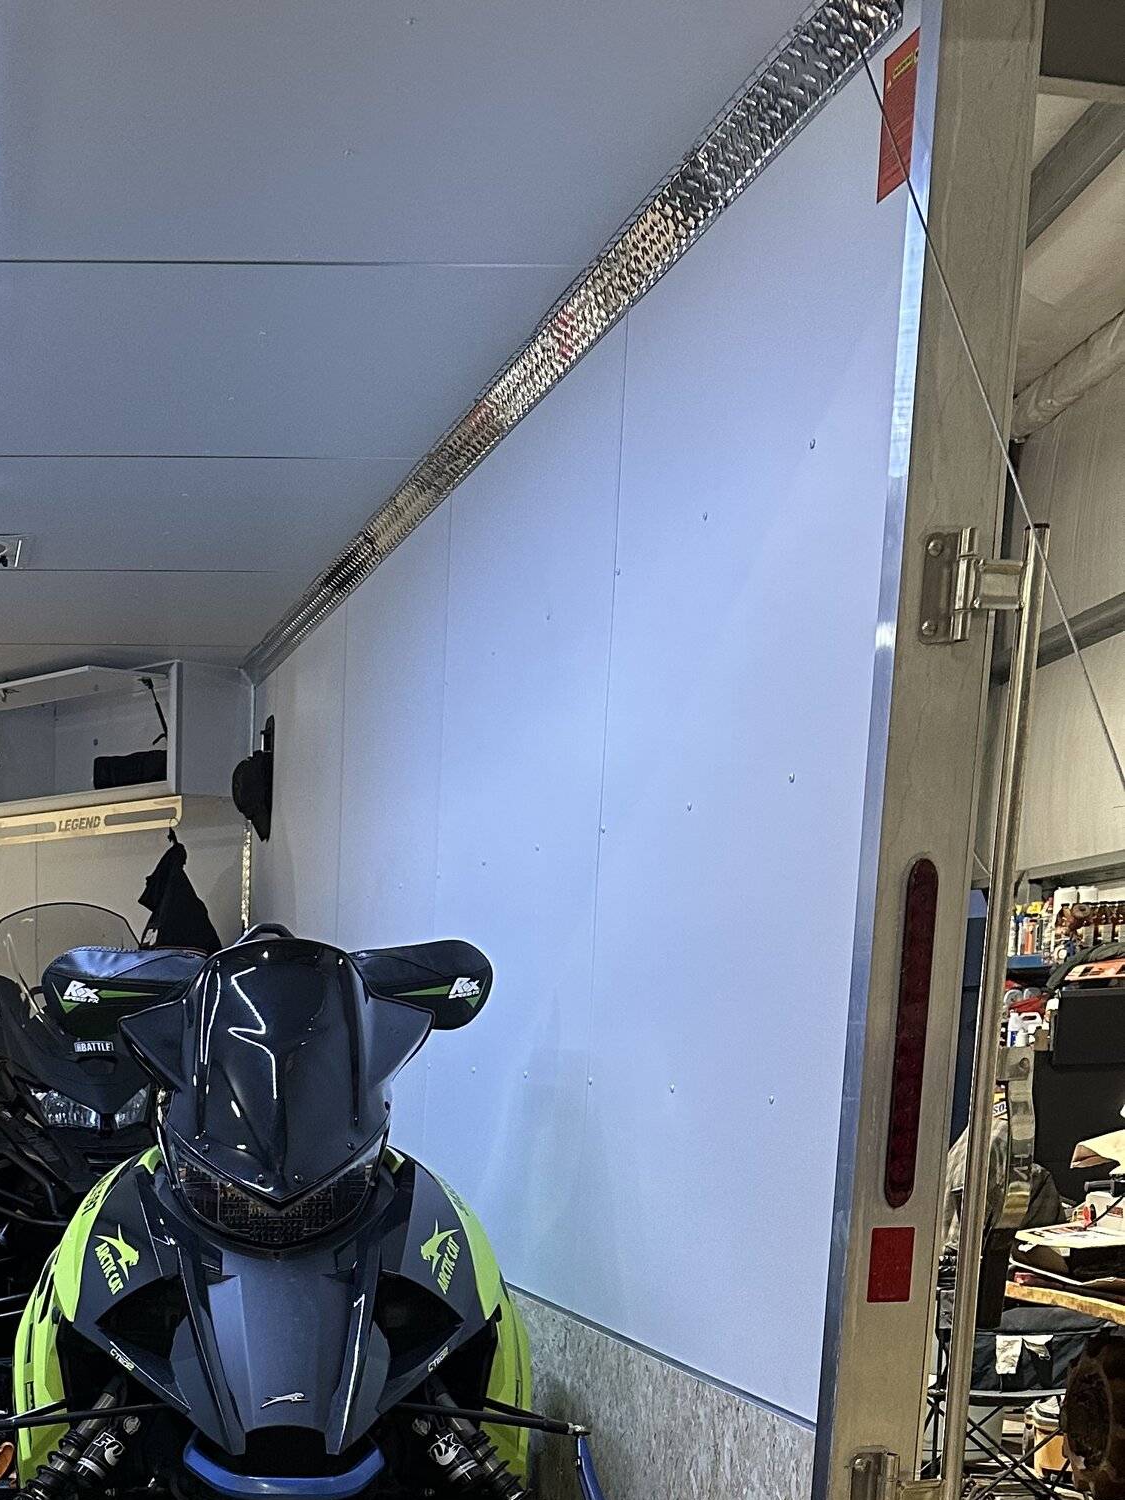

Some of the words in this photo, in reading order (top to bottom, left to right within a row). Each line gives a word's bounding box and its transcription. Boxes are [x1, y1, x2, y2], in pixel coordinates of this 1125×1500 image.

[58, 816, 101, 832] LEGEND
[95, 1242, 116, 1279] ARCTIC
[108, 1273, 124, 1295] CAT
[437, 1253, 455, 1295] ARCTIC
[446, 1236, 460, 1260] CAT
